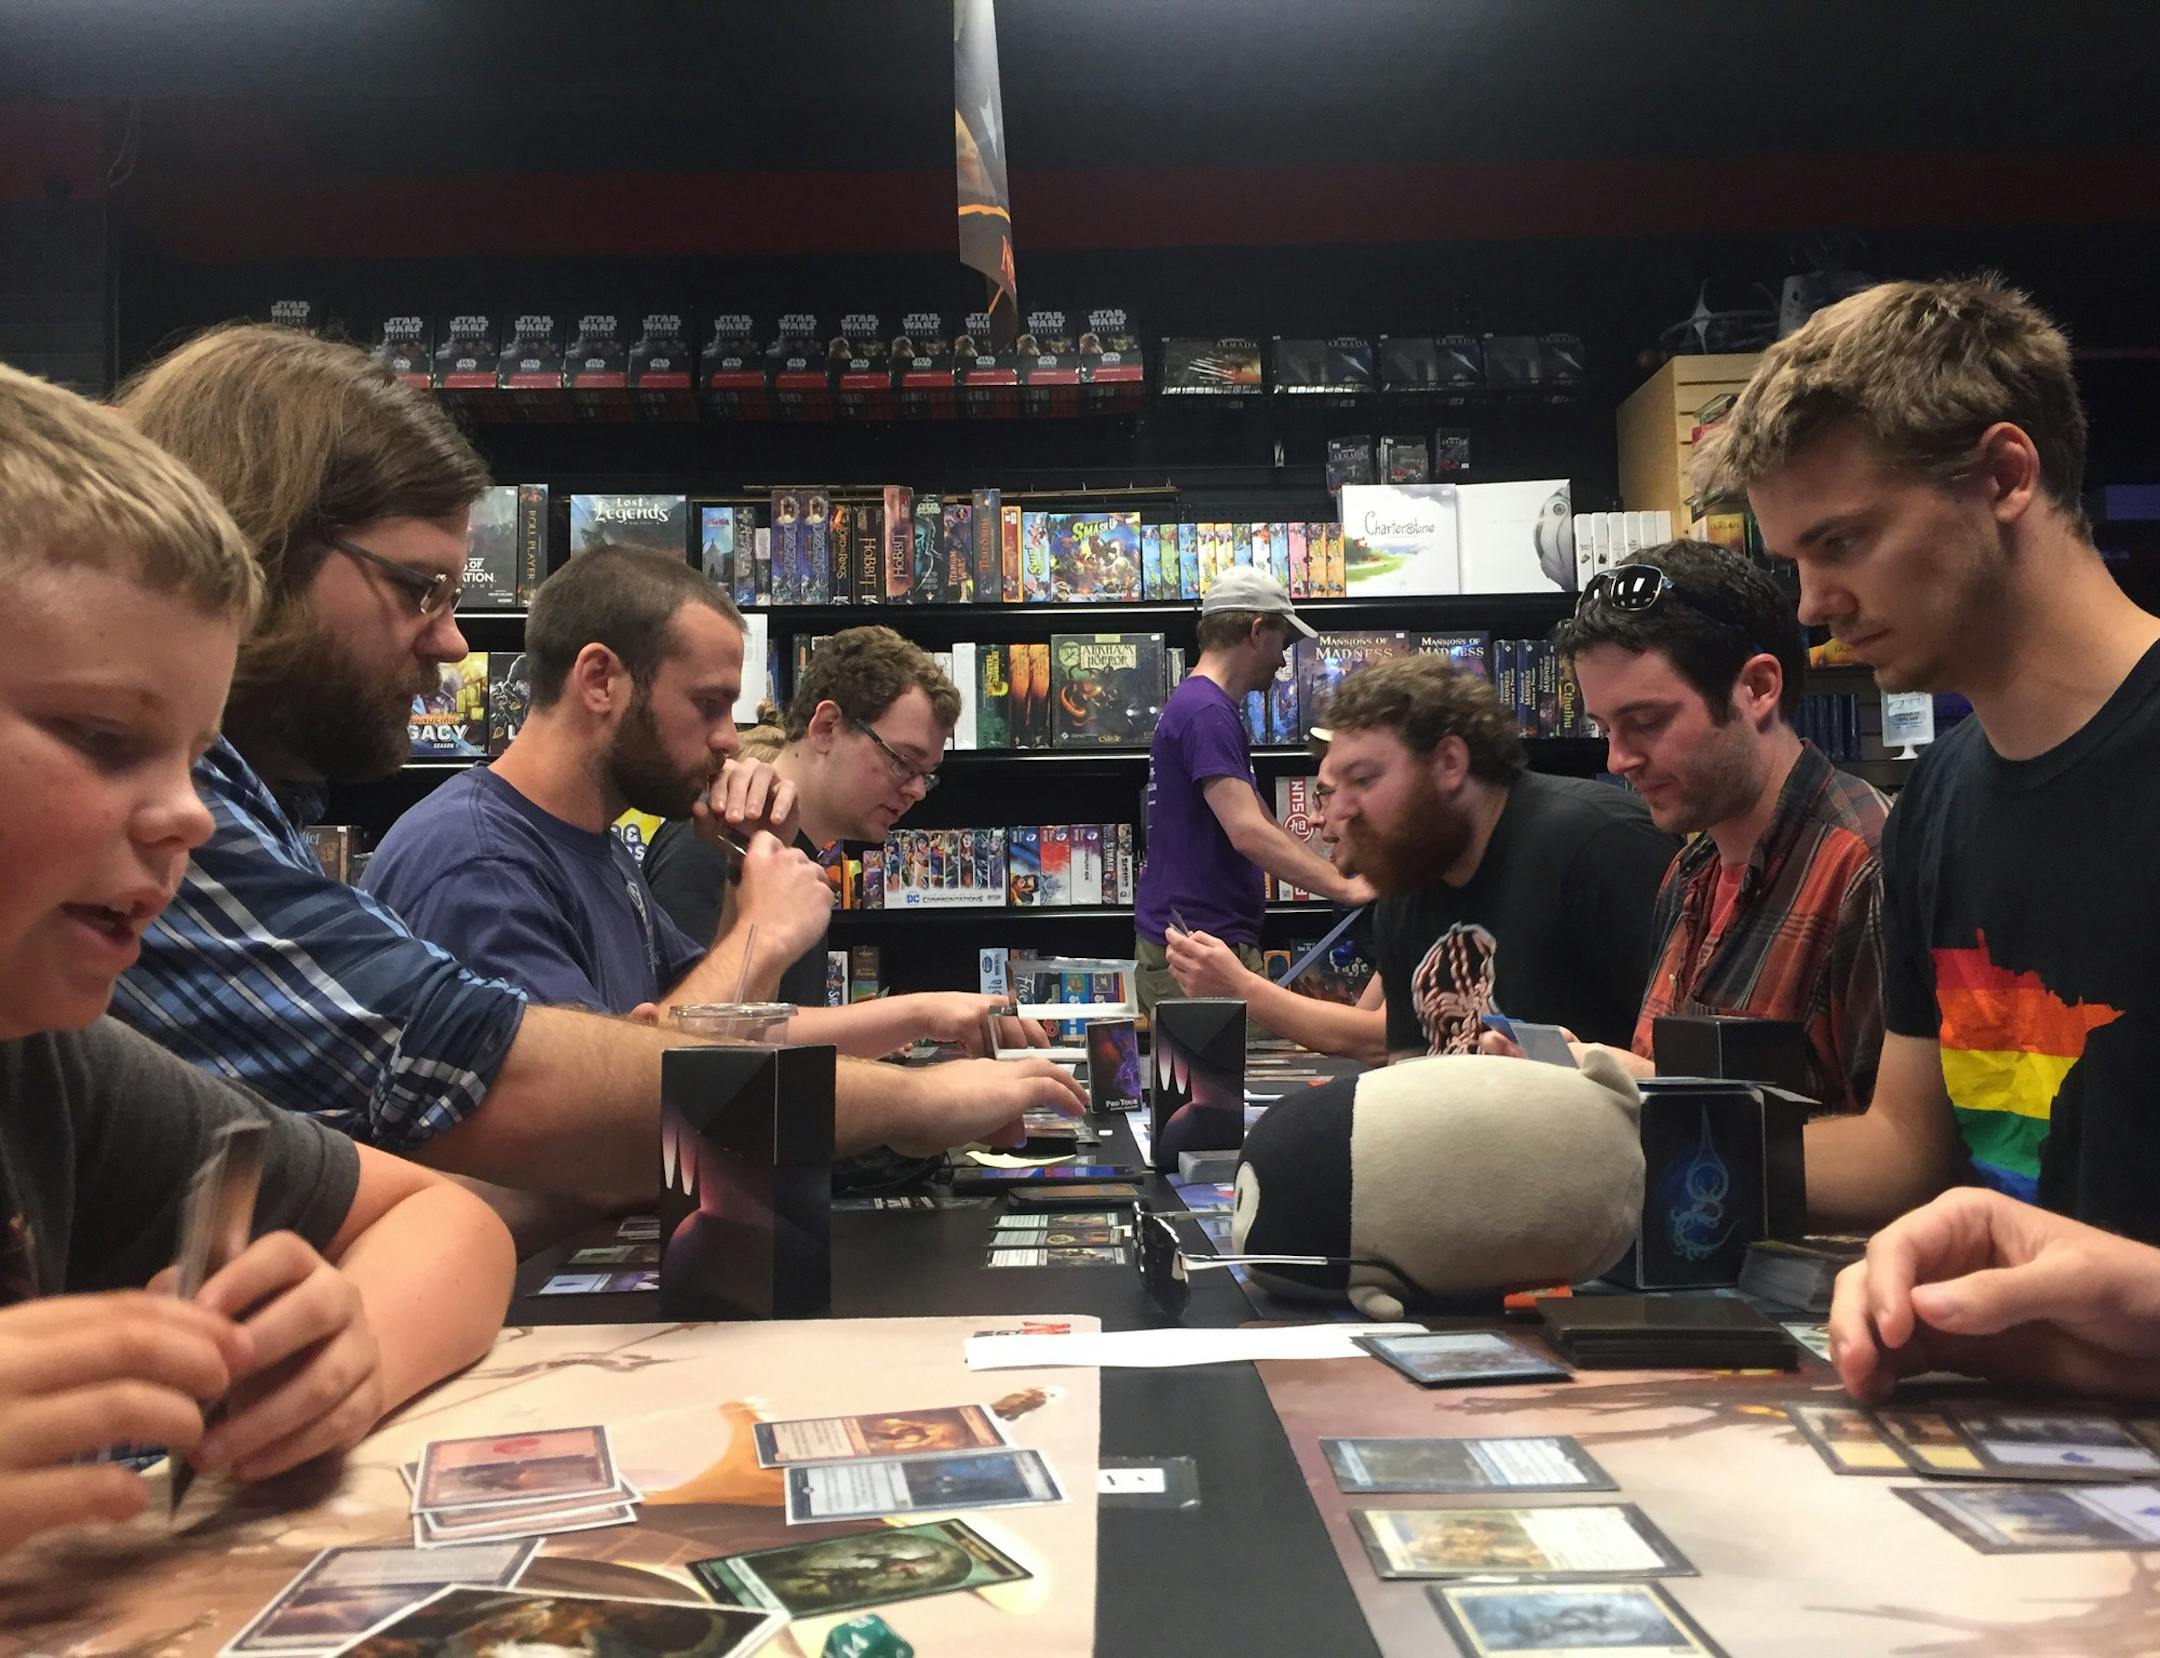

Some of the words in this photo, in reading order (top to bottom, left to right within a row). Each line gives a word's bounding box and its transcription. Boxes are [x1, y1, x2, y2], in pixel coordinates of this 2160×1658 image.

[275, 300, 309, 309] STAR
[271, 305, 310, 317] WARS
[907, 313, 940, 321] STAR
[1093, 309, 1126, 317] STAR
[388, 316, 422, 325] STAR
[519, 315, 552, 323] STAR
[583, 315, 616, 323] STAR
[647, 314, 680, 323] STAR
[719, 314, 752, 323] STAR
[783, 314, 816, 322] STAR
[840, 318, 879, 330] WARS
[845, 314, 877, 322] STAR
[902, 318, 941, 330] WARS
[1027, 315, 1066, 327] WARS
[1088, 314, 1127, 326] WARS
[383, 321, 423, 333] WARS
[450, 321, 488, 332] WARS
[515, 320, 554, 332] WARS
[579, 320, 618, 332] WARS
[643, 319, 681, 331] WARS
[714, 319, 753, 331] WARS
[778, 319, 817, 330] WARS
[617, 498, 643, 507] Lost
[593, 503, 669, 523] Legends
[1364, 511, 1436, 536] Charterstone
[469, 560, 484, 569] OF
[859, 537, 877, 589] HOBBIT
[1319, 635, 1369, 647] MANSIONS
[1375, 636, 1389, 645] OF
[1469, 637, 1481, 645] OF
[1082, 645, 1134, 656] ARKHAM
[1315, 647, 1393, 661] MADNESS
[1563, 682, 1576, 728] Cthulhu
[407, 725, 468, 741] GACY
[1292, 780, 1304, 812] SUN
[906, 894, 920, 903] DC
